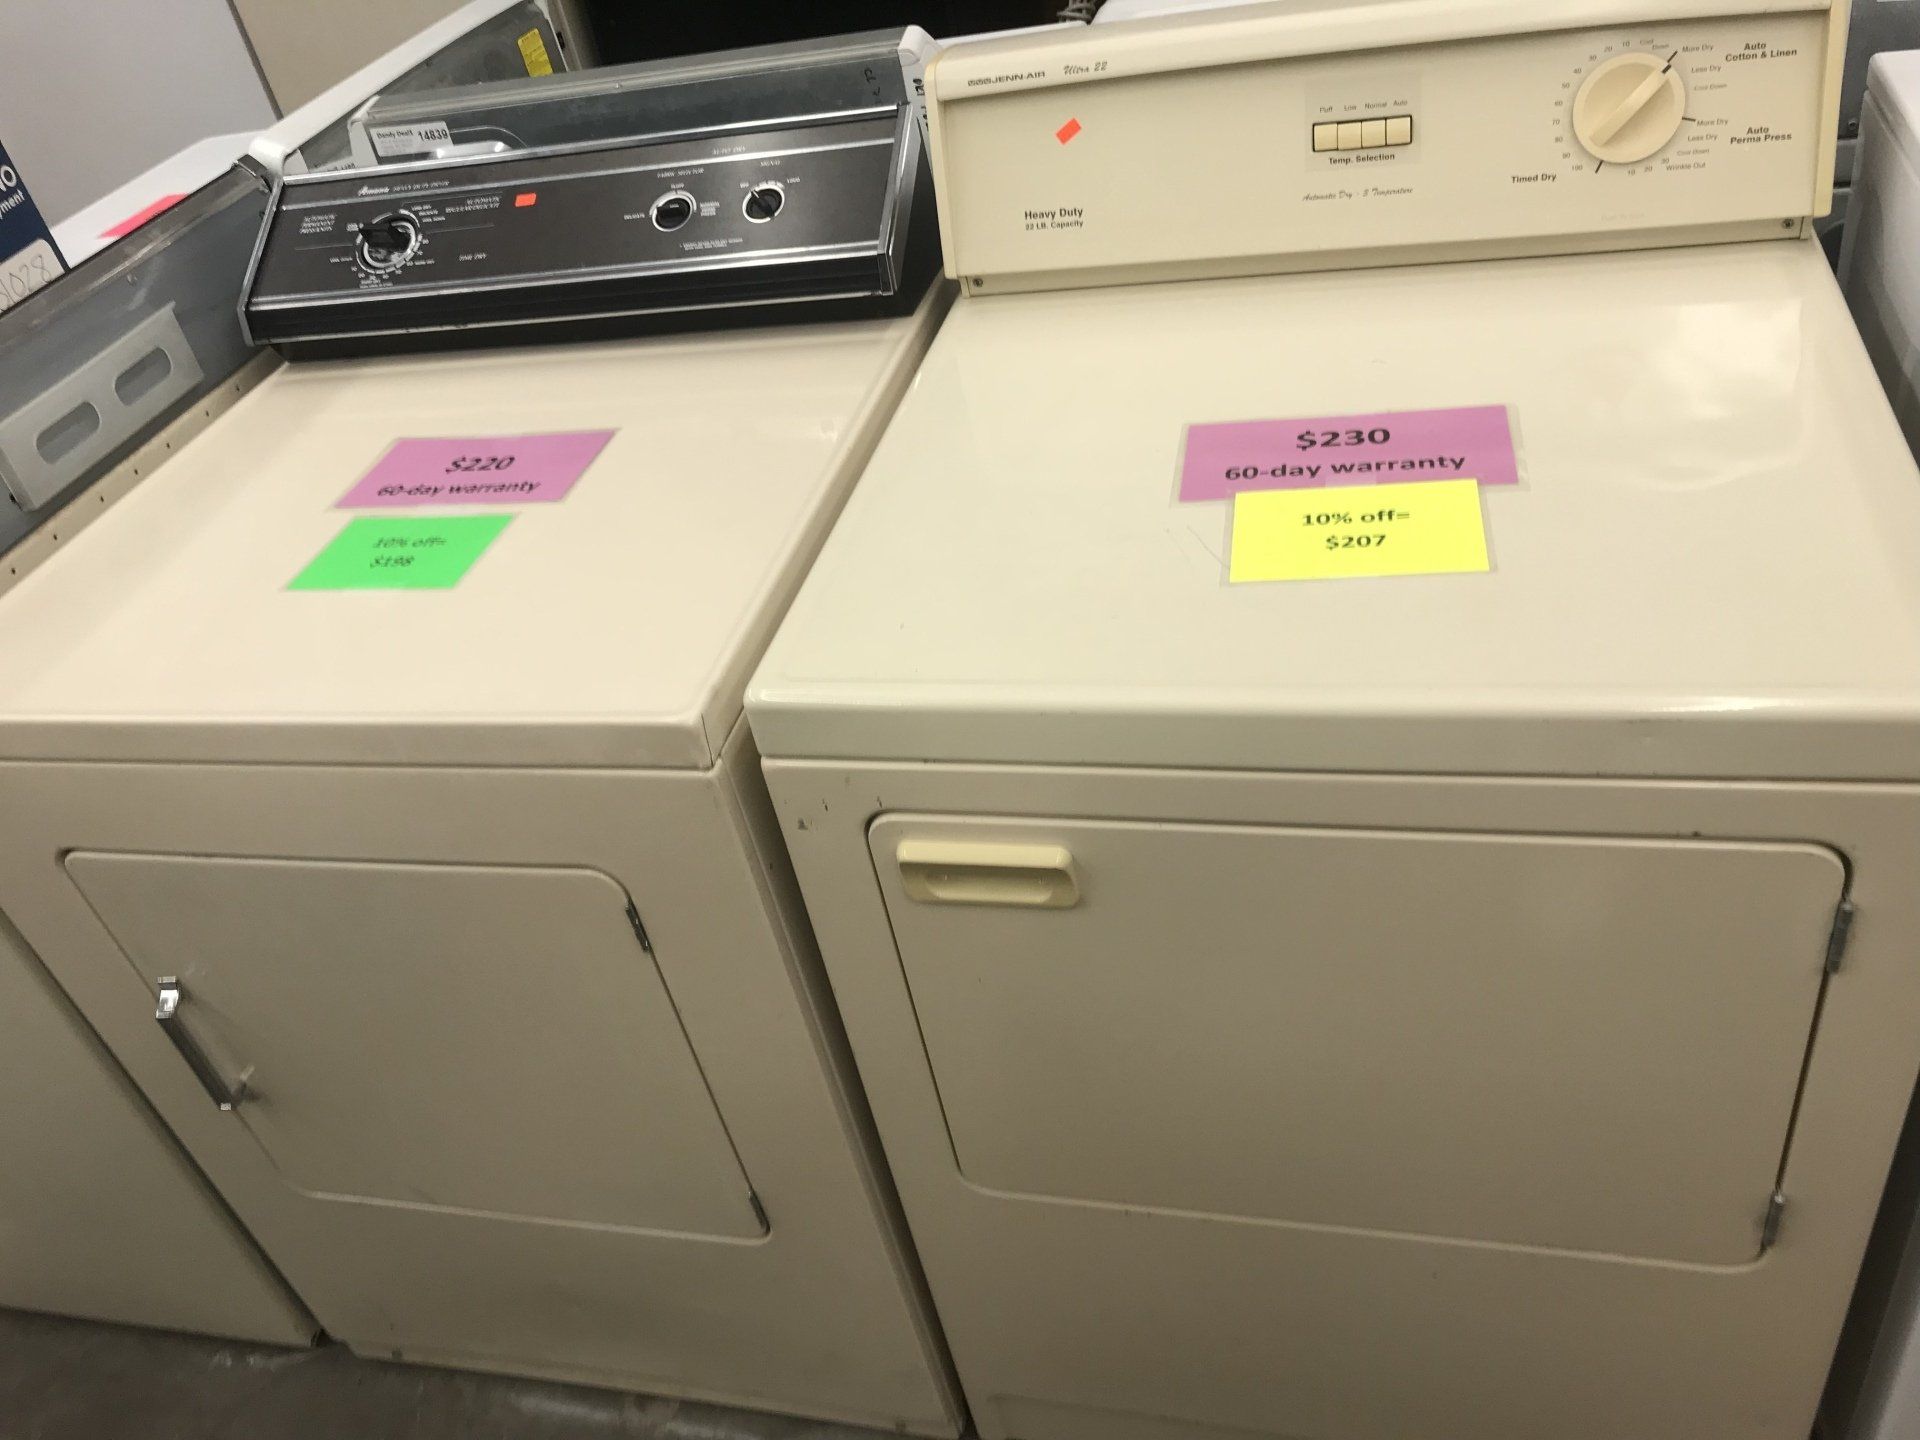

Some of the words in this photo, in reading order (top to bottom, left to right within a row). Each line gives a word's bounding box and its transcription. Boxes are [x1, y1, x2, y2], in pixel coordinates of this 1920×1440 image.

[1744, 42, 1767, 51] Auto
[1725, 52, 1758, 62] Cotton
[1760, 50, 1767, 59] &
[1770, 48, 1798, 58] Linen
[1063, 64, 1090, 76] Ultra
[1094, 61, 1108, 72] 22
[418, 129, 449, 141] 14839
[1746, 126, 1770, 135] Auto
[1730, 135, 1761, 145] Perma
[1764, 132, 1793, 142] Press
[1329, 157, 1353, 166] Temp.
[1356, 153, 1395, 163] Selection
[1511, 174, 1539, 184] Timed
[1541, 173, 1557, 183] Dry
[1024, 209, 1056, 221] Heavy
[1059, 207, 1083, 218] Duty
[1050, 219, 1083, 230] Capacity
[1296, 428, 1391, 451] $230
[445, 455, 515, 474] $220
[1225, 462, 1322, 481] 60-day
[1331, 455, 1466, 474] warranty
[377, 482, 444, 498] 60-day
[448, 480, 541, 496] warranty
[1302, 511, 1353, 527] 10%
[1360, 509, 1411, 524] off=
[373, 537, 408, 549] 10%
[1325, 534, 1387, 551] $207
[369, 554, 415, 569] $198
